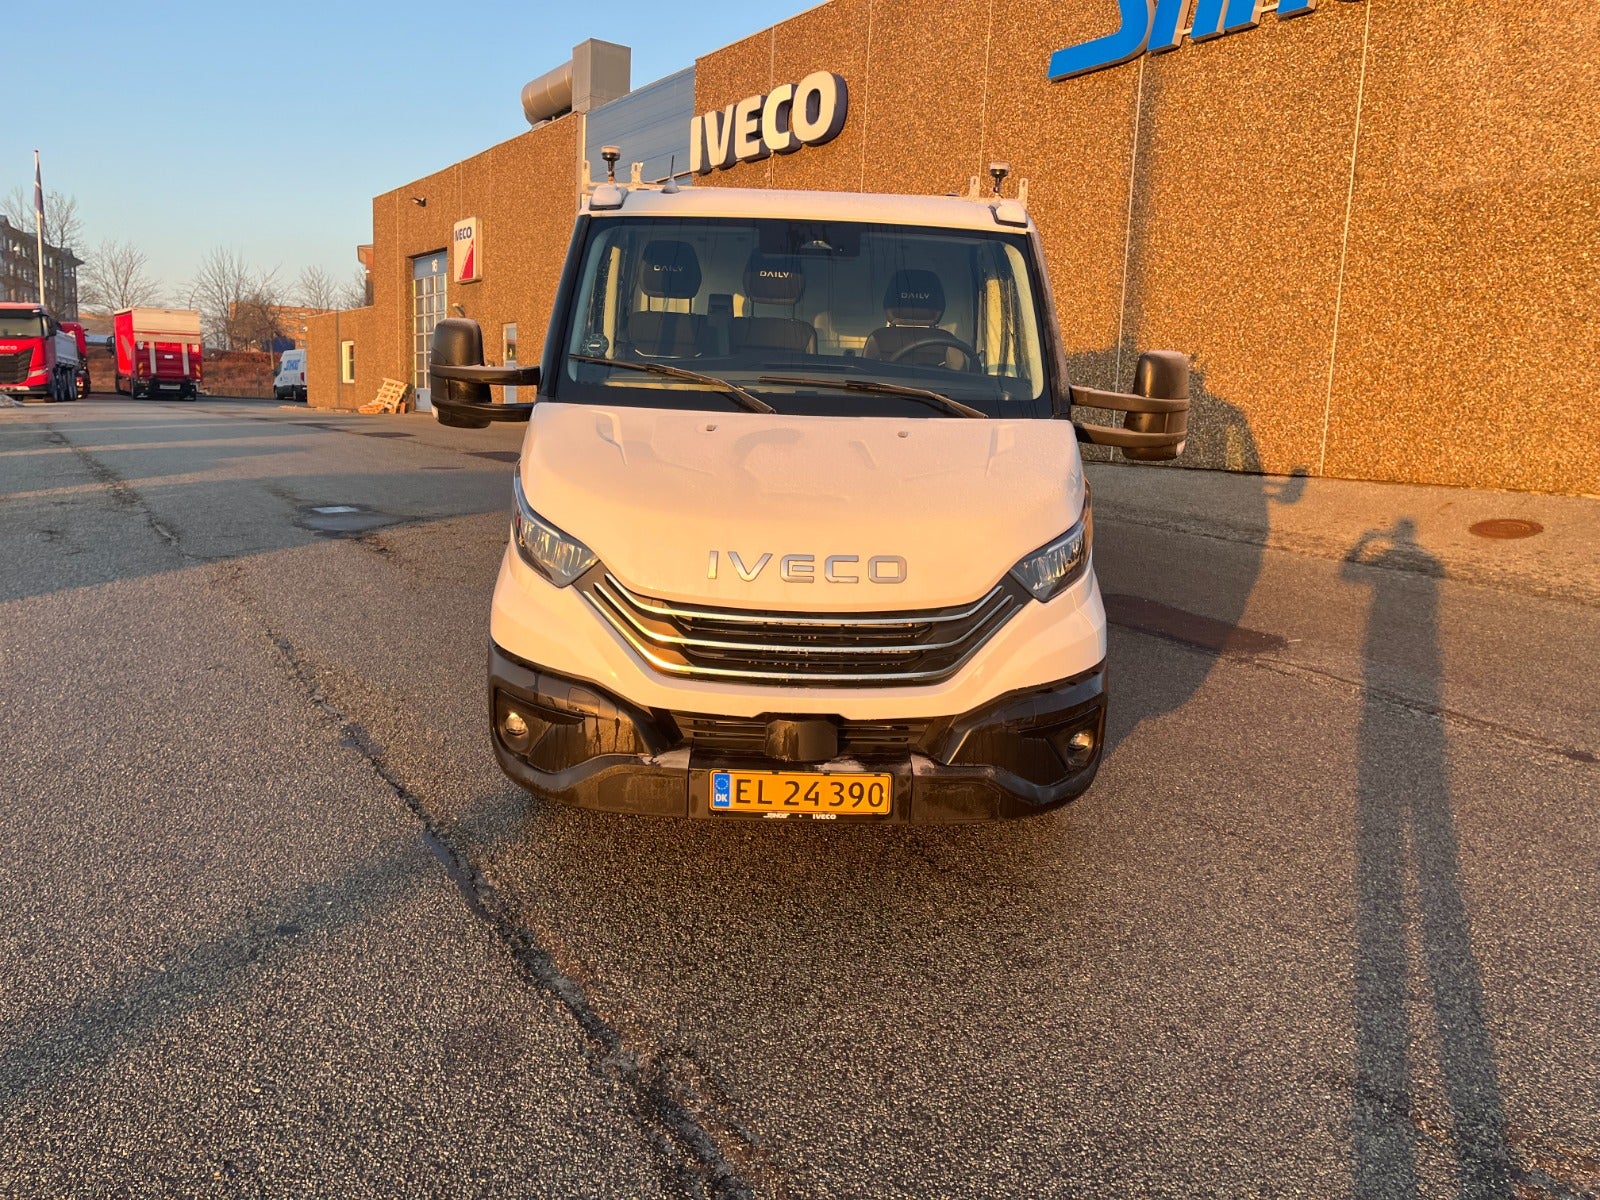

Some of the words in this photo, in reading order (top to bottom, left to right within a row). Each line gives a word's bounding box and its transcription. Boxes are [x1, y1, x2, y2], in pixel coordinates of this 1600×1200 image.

[690, 71, 843, 174] IVECO
[455, 226, 472, 242] IVECO
[759, 270, 790, 278] DAILY
[900, 292, 930, 300] DAILY
[706, 550, 908, 584] IVECO
[715, 793, 728, 803] DK
[735, 779, 773, 805] EL
[783, 780, 820, 807] 24
[829, 781, 884, 808] 390
